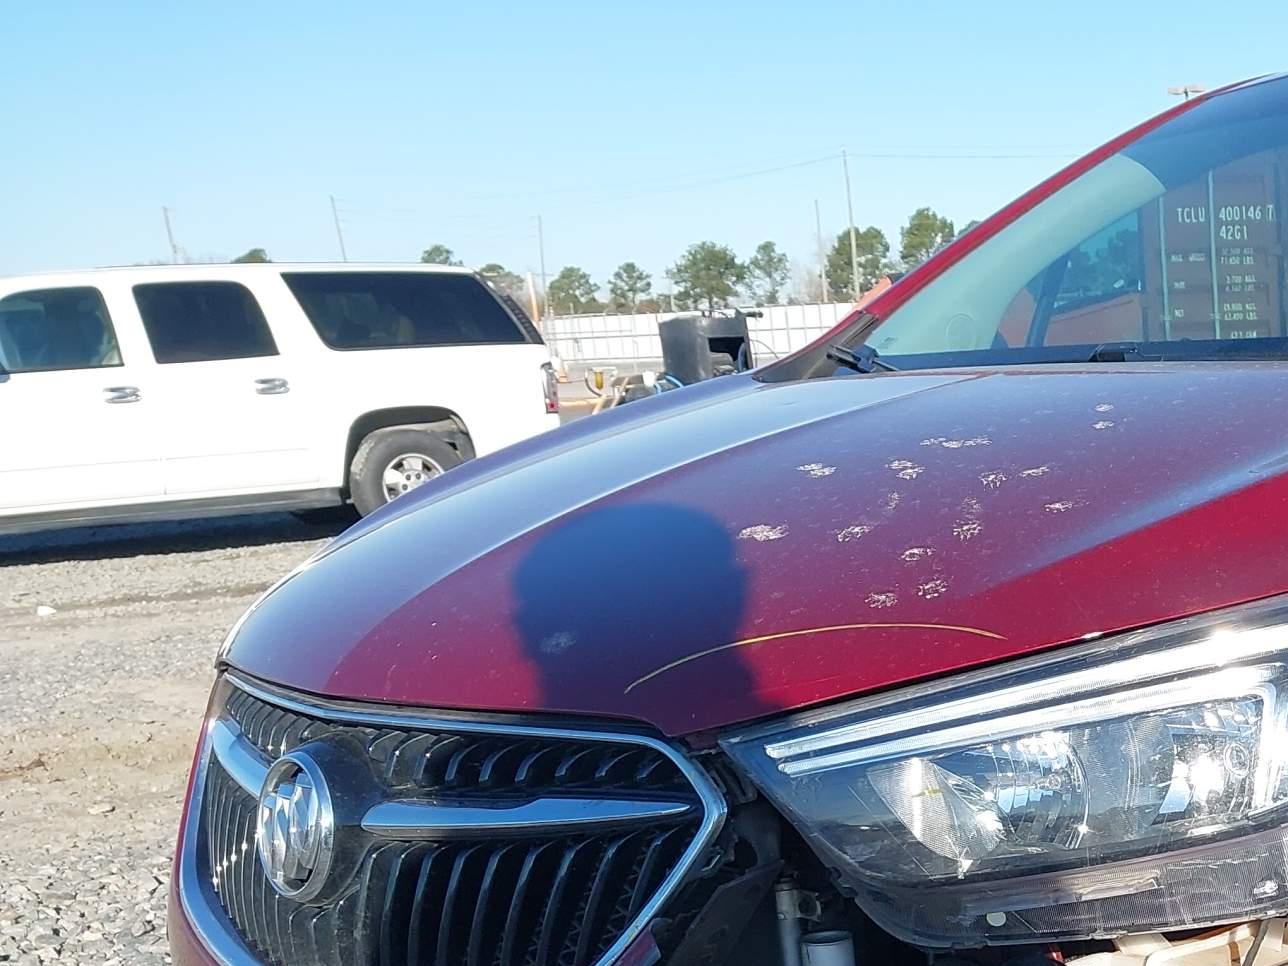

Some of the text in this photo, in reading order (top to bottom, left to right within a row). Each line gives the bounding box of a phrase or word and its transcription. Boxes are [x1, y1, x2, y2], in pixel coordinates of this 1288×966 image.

[1176, 207, 1205, 223] TCLU
[1219, 205, 1262, 221] 400146
[1220, 225, 1248, 240] 42G1
